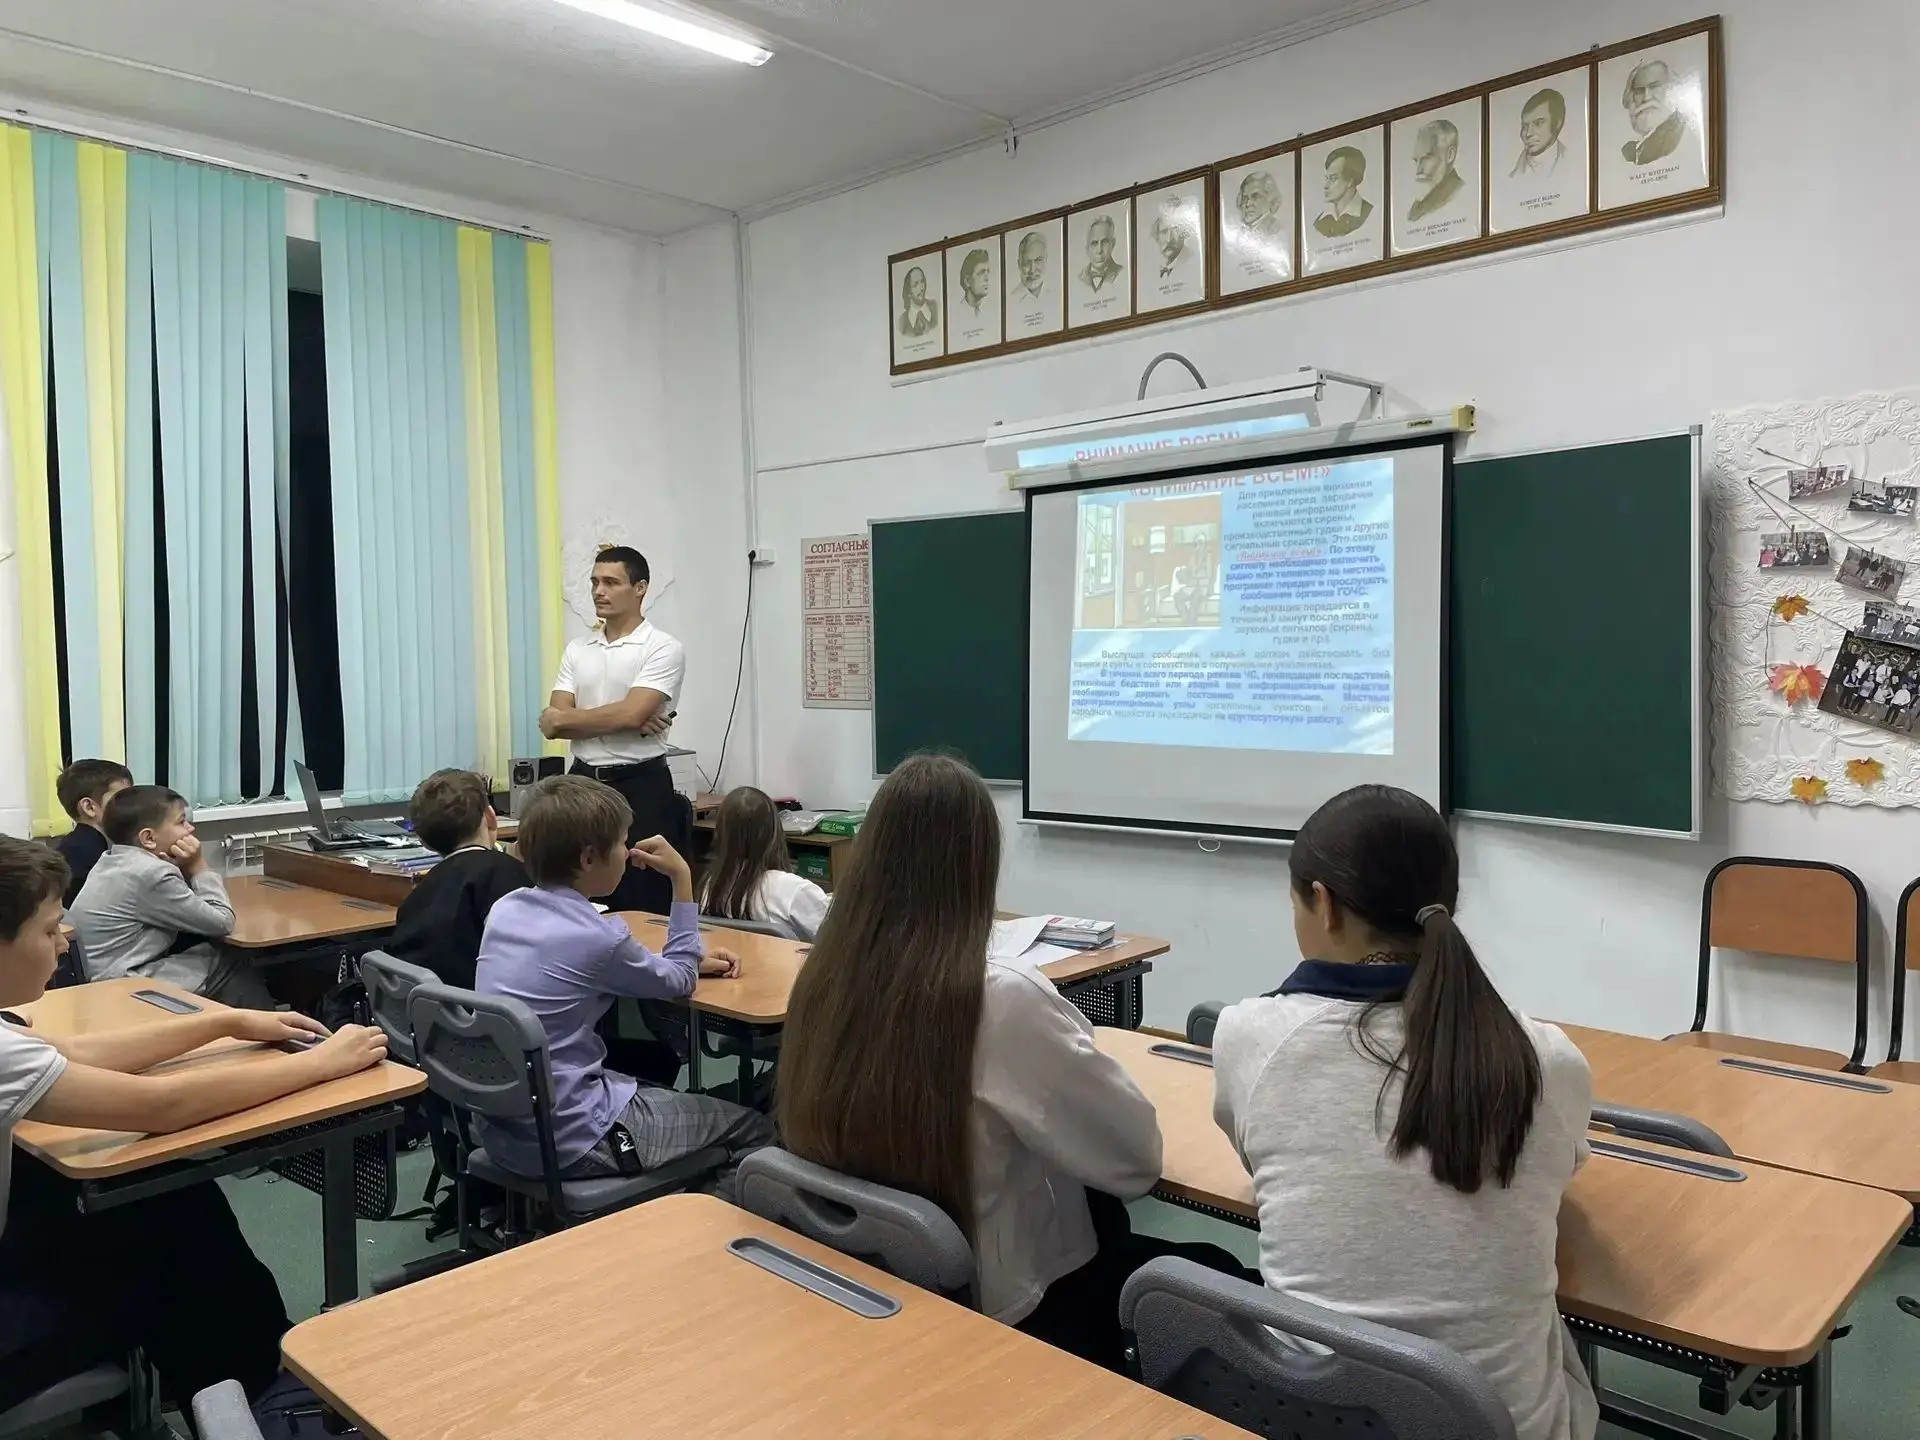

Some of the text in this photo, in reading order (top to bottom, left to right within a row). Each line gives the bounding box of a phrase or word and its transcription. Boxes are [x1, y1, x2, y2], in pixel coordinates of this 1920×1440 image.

[1239, 491, 1256, 500] Для
[1288, 496, 1316, 506] перед
[1294, 503, 1356, 515] информации
[1352, 533, 1388, 541] сигнал
[1330, 546, 1343, 554] По
[1345, 545, 1375, 554] этому
[1278, 614, 1307, 625] минут
[1342, 612, 1379, 622] подачи
[1324, 670, 1391, 681] последствий
